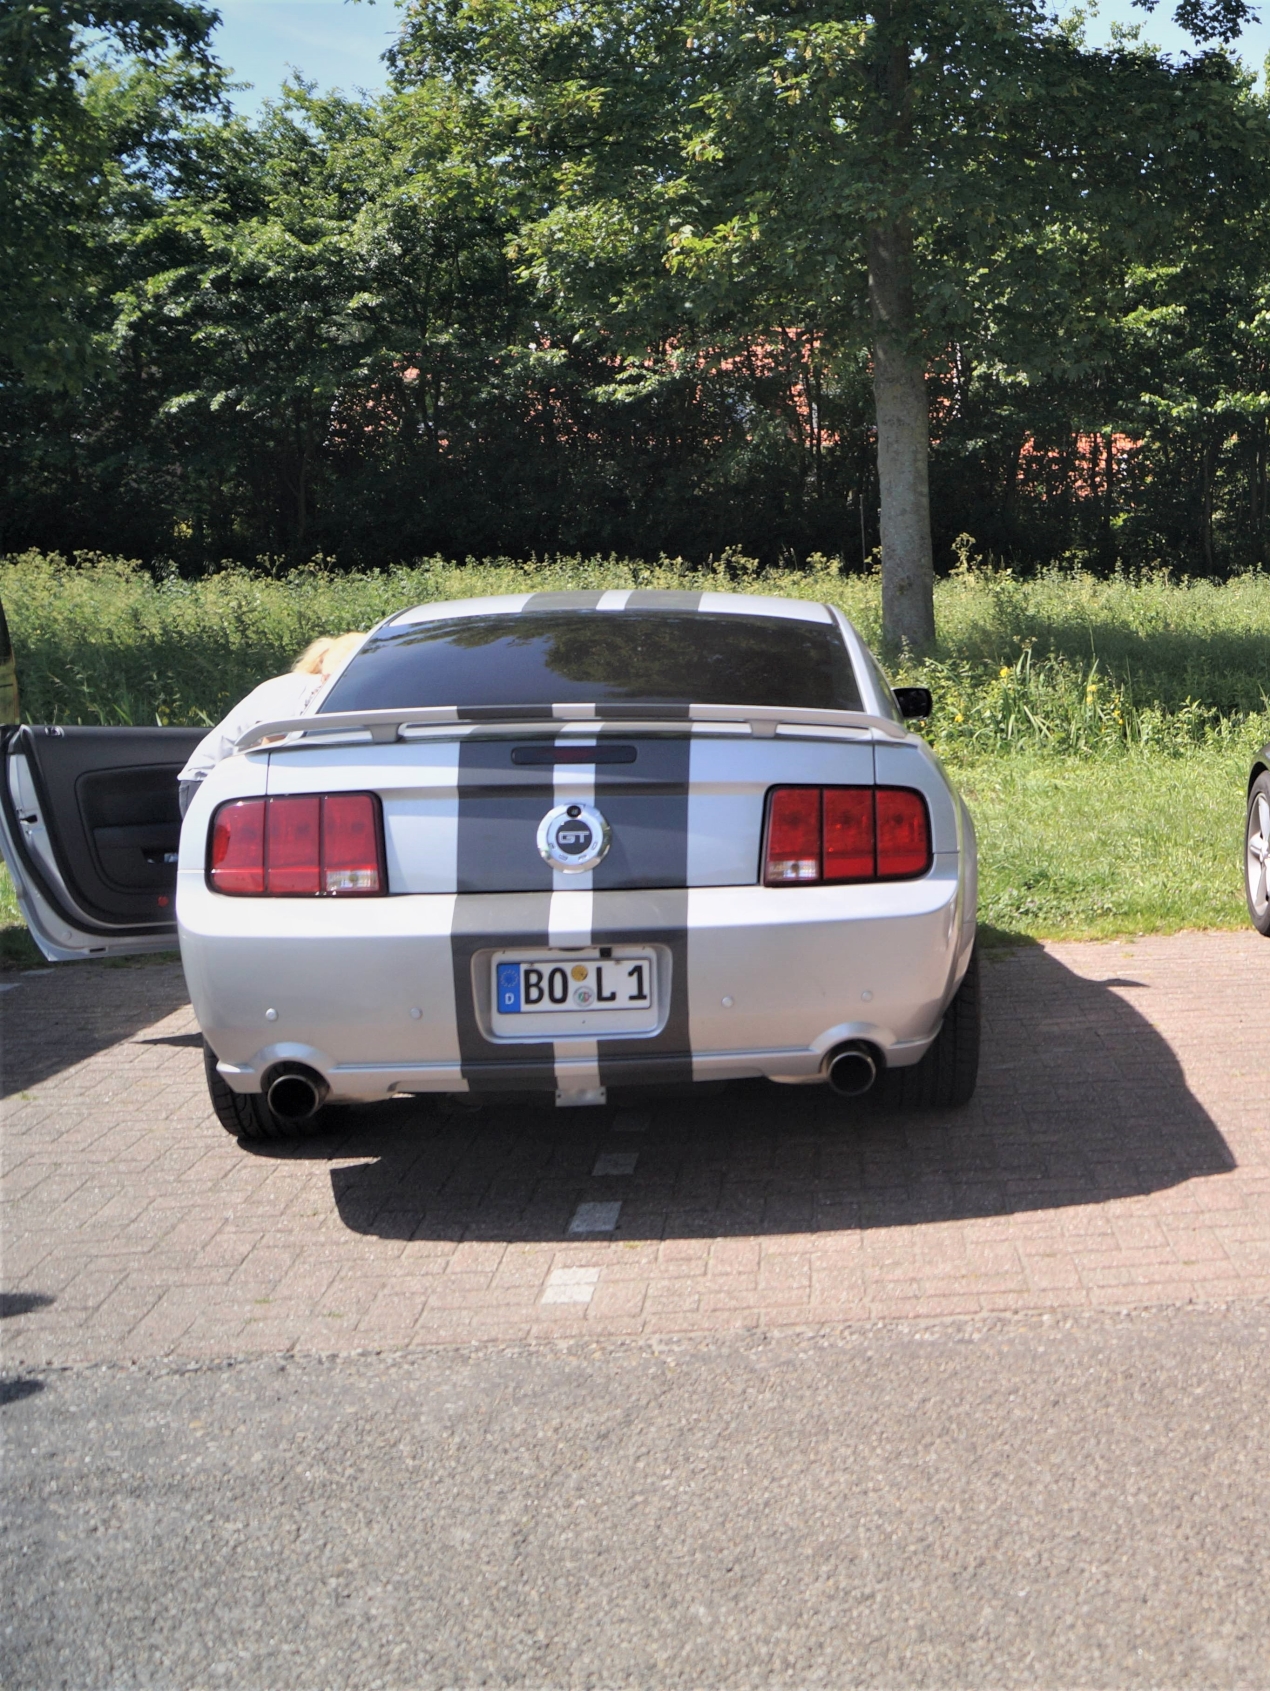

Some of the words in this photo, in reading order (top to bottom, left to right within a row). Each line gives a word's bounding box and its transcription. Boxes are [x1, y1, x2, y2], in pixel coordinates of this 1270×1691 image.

[559, 831, 590, 844] GT
[524, 967, 568, 1005] BO
[596, 966, 616, 1002] L
